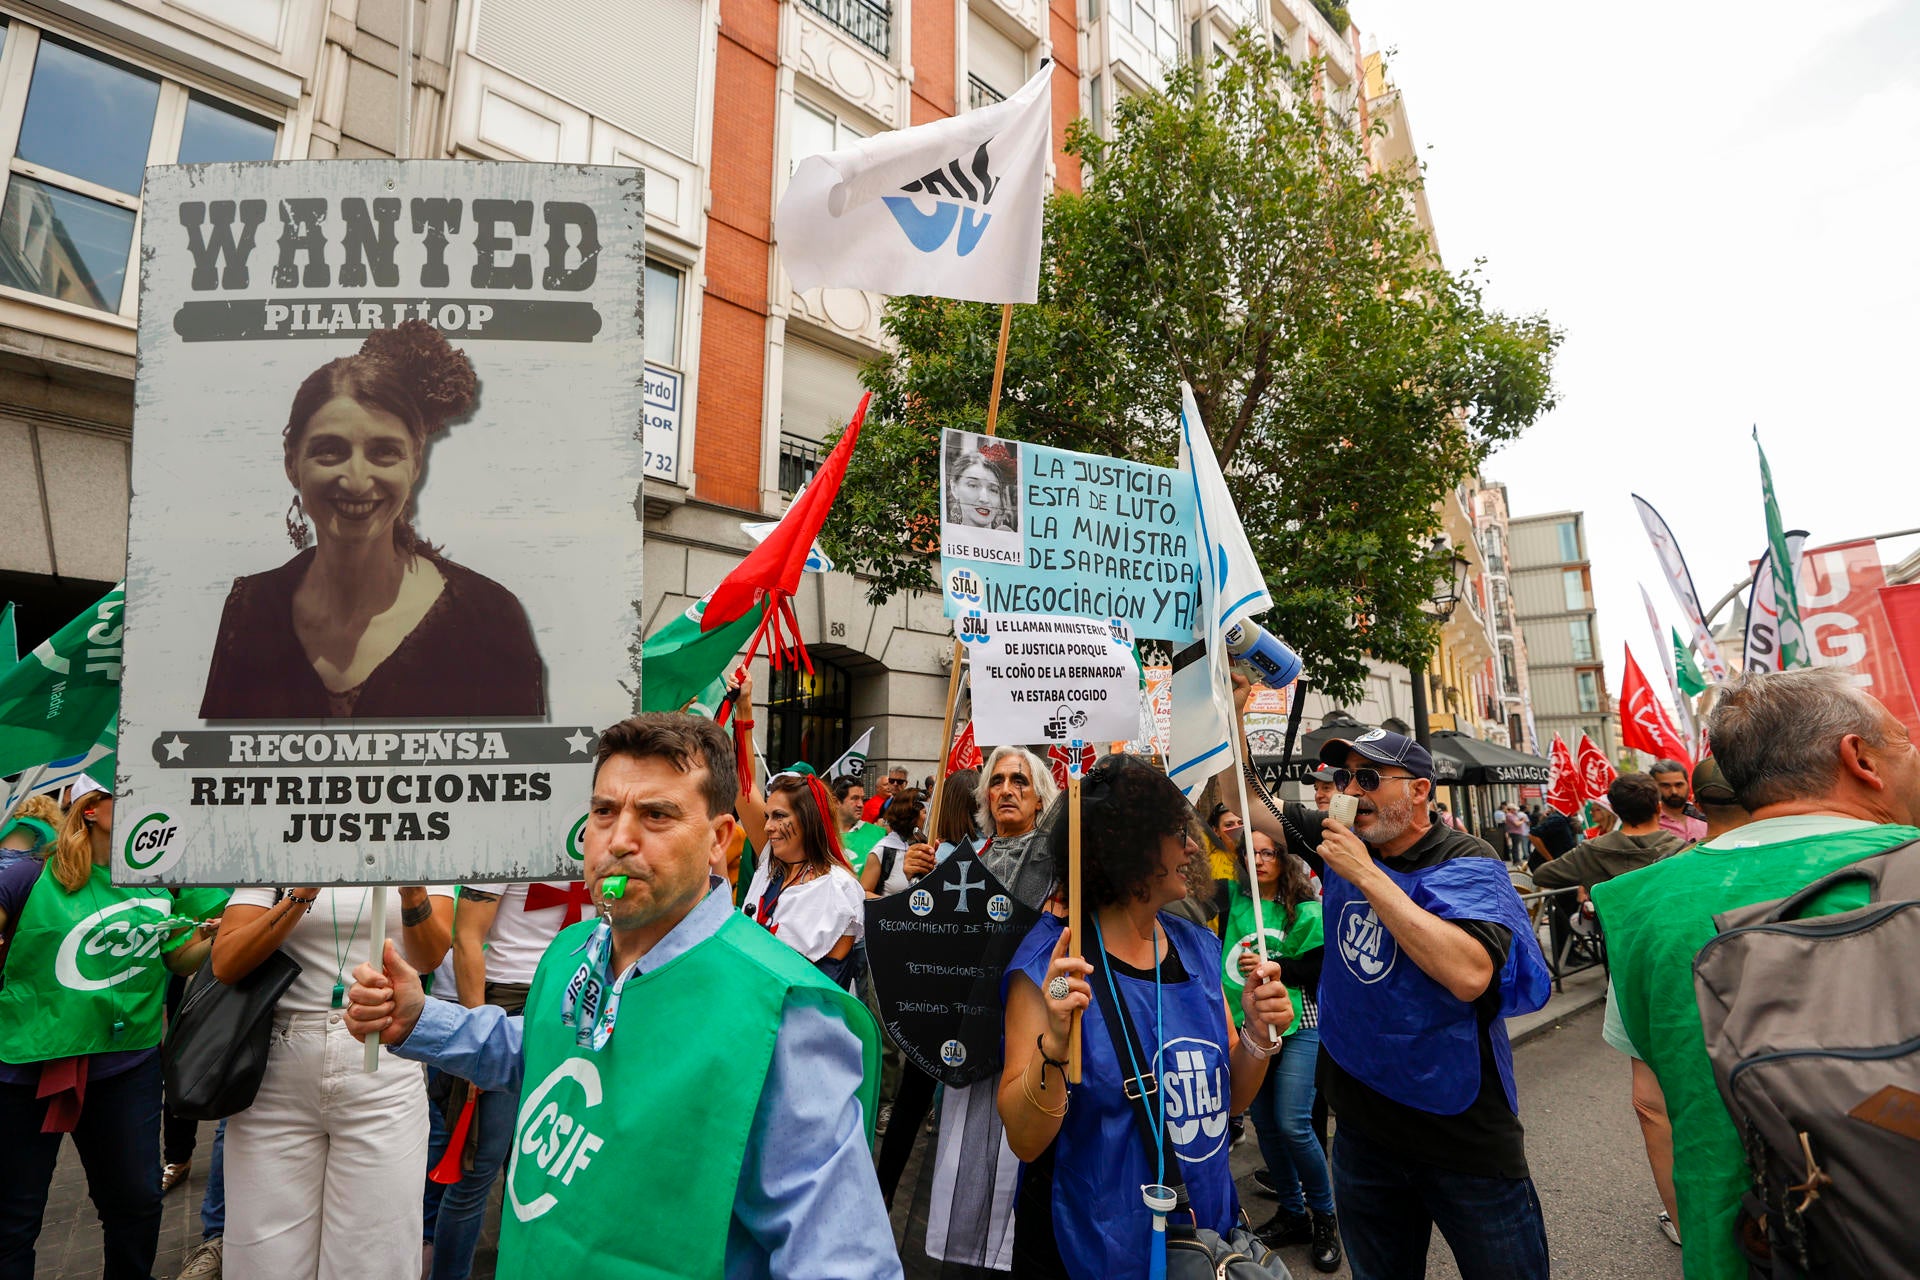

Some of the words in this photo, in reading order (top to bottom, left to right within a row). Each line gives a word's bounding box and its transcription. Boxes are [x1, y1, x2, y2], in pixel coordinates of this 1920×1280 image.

[179, 197, 603, 292] WANTED
[264, 303, 385, 333] PILAR
[644, 381, 671, 400] ardo
[644, 414, 673, 431] LOR
[644, 451, 653, 467] 7
[656, 454, 672, 472] 32
[1034, 454, 1065, 479] LA
[1073, 461, 1172, 497] JUSTICIA
[1089, 491, 1107, 511] DE
[1117, 494, 1180, 526] LUTO,
[1031, 516, 1058, 539] LA
[1073, 516, 1186, 557] MINISTRA
[973, 547, 1020, 562] BUSCA!!
[953, 576, 978, 595] STAJ
[1153, 587, 1196, 630] YA!
[963, 617, 988, 635] STAJ
[996, 621, 1008, 632] LE
[1011, 622, 1052, 633] LLAMAN
[1054, 623, 1107, 636] MINISTERIO
[1796, 551, 1873, 688] UG
[831, 622, 846, 637] 58
[1108, 624, 1128, 642] STAJ
[1225, 627, 1242, 642] TAJ
[1005, 643, 1019, 655] DE
[1021, 643, 1065, 655] JUSTICIA
[1067, 644, 1107, 658] PORQUE
[986, 666, 1004, 678] "EL
[1006, 663, 1035, 678] COÑO
[1038, 666, 1051, 678] DE
[1053, 666, 1067, 678] LA
[1069, 666, 1125, 678] BERNARDA"
[47, 681, 67, 720] Madrid
[1010, 690, 1024, 702] YA
[1026, 690, 1065, 702] ESTABA
[1067, 689, 1107, 701] COGIDO
[229, 731, 509, 765] RECOMPENSA
[1496, 767, 1551, 782] SANTAGLO
[190, 772, 551, 805] RETRIBUCIONES
[283, 811, 451, 843] JUSTAS
[135, 826, 177, 852] CSIF
[912, 896, 929, 907] STAJ
[990, 901, 1009, 912] STAJ
[879, 919, 959, 934] RECONOCIMIENTO
[963, 924, 981, 934] DE
[906, 962, 985, 977] RETRIBUCIONES
[568, 966, 588, 1005] CSIF
[581, 980, 600, 1019] CSIF
[896, 1000, 949, 1015] DIGNIDAD
[944, 1046, 962, 1057] STAJ
[1163, 1067, 1222, 1118] STAJ
[521, 1101, 605, 1186] CSIF
